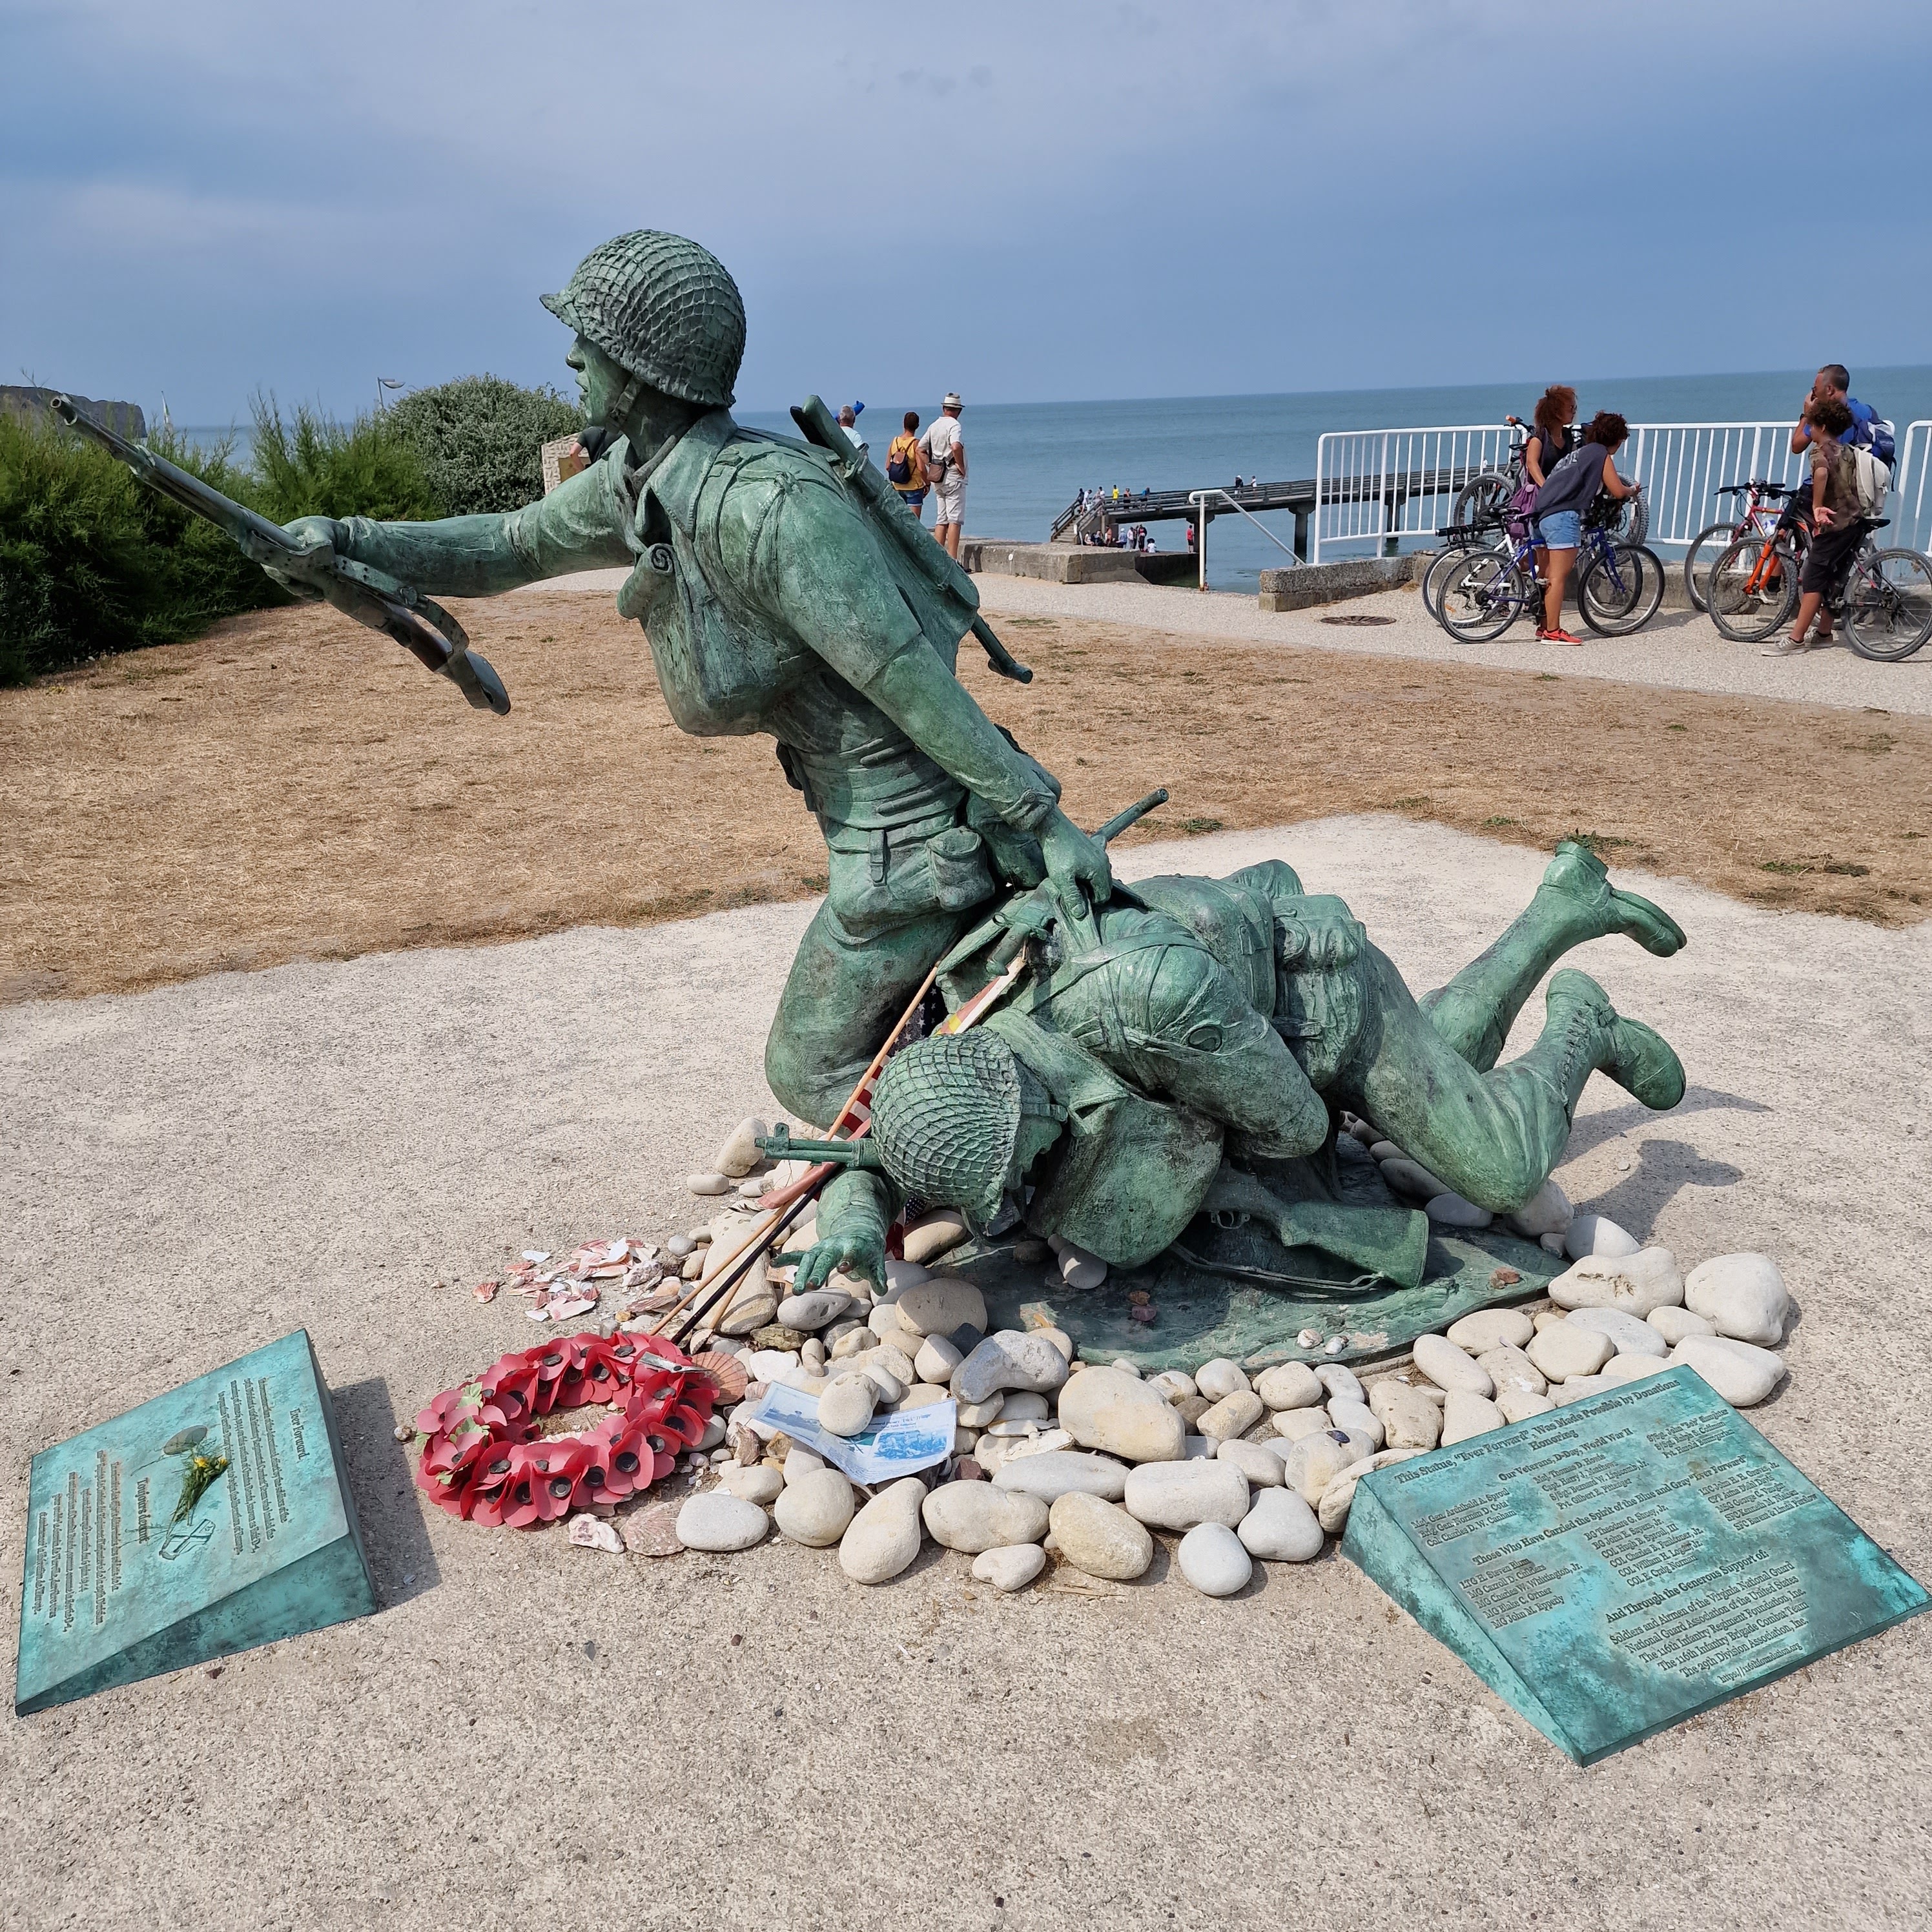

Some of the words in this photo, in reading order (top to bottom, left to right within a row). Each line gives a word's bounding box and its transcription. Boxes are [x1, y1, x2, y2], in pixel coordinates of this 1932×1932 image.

[289, 1406, 303, 1428] Ever
[1393, 1468, 1421, 1484] This
[1417, 1455, 1459, 1477] Statue,
[1530, 1421, 1557, 1435] Was
[1553, 1411, 1585, 1427] Made
[1579, 1397, 1623, 1418] Possible
[1618, 1393, 1638, 1406] by
[1630, 1377, 1681, 1400] Donations
[293, 1423, 310, 1461] Forward
[1496, 1469, 1518, 1481] Our
[1513, 1455, 1557, 1476] Veterans,
[1551, 1445, 1585, 1463] D-Day,
[1577, 1436, 1608, 1452] World
[1604, 1430, 1626, 1442] War
[1621, 1427, 1634, 1436] II
[1526, 1427, 1579, 1452] Honoring
[1547, 1463, 1577, 1478] Thomas
[1582, 1452, 1607, 1465] Howie
[1557, 1472, 1583, 1487] Harry
[1584, 1459, 1619, 1476] Matthews
[1568, 1477, 1598, 1493] Bernard
[1594, 1474, 1608, 1483] W.
[1603, 1462, 1641, 1481] Lipscomb,
[1636, 1459, 1650, 1468] Jr.
[134, 1475, 150, 1517] Toujours
[1443, 1499, 1479, 1517] Archibald
[1483, 1487, 1512, 1503] Sproul
[1569, 1490, 1596, 1505] Gilbert
[1599, 1476, 1634, 1494] Pittenger
[1439, 1526, 1469, 1541] Charles
[1464, 1522, 1478, 1532] D.
[1474, 1518, 1489, 1528] W.
[1485, 1508, 1517, 1525] Canham
[1451, 1509, 1483, 1525] Norman
[1489, 1499, 1509, 1511] Cota
[1471, 1548, 1503, 1566] Those
[1497, 1540, 1523, 1556] Who
[1519, 1532, 1546, 1547] Have
[1541, 1519, 1577, 1538] Carried
[1572, 1514, 1592, 1526] the
[1587, 1505, 1617, 1522] Spirit
[1610, 1501, 1625, 1512] of
[1619, 1496, 1638, 1508] the
[1633, 1489, 1657, 1503] Blue
[1652, 1483, 1672, 1495] and
[1668, 1475, 1694, 1491] Gray
[1582, 1530, 1599, 1541] BG
[1594, 1517, 1629, 1536] Theodore
[1590, 1539, 1607, 1550] BG
[1602, 1532, 1624, 1545] John
[1599, 1546, 1620, 1559] COL
[1614, 1539, 1639, 1554] Hugh
[1641, 1526, 1671, 1543] Sproul,
[1665, 1523, 1680, 1533] III
[1608, 1556, 1629, 1568] COL
[1623, 1545, 1653, 1562] Charles
[1466, 1587, 1485, 1599] MG
[1481, 1577, 1509, 1593] Carroll
[1514, 1562, 1547, 1580] Childers
[1485, 1563, 1512, 1579] Steven
[1508, 1556, 1531, 1570] Blum
[1616, 1565, 1637, 1577] COL
[1632, 1554, 1663, 1571] William
[1625, 1574, 1646, 1587] COL
[1648, 1563, 1673, 1579] Craig
[1666, 1553, 1698, 1570] Norman
[1474, 1596, 1493, 1609] MG
[1488, 1586, 1519, 1603] Charles
[1514, 1582, 1530, 1592] W.
[1525, 1565, 1574, 1590] Whittington,
[1568, 1561, 1583, 1571] Jr.
[1481, 1606, 1501, 1619] MG
[1496, 1598, 1521, 1613] Blake
[1525, 1585, 1554, 1601] Ortner
[1601, 1607, 1628, 1623] And
[1621, 1590, 1669, 1617] Through
[1660, 1585, 1681, 1599] the
[1676, 1567, 1723, 1592] Generous
[1717, 1553, 1760, 1577] Support
[1752, 1548, 1770, 1560] of:
[1490, 1616, 1509, 1629] MG
[1505, 1609, 1527, 1623] John
[1534, 1594, 1568, 1614] Epperly
[1607, 1623, 1645, 1645] Soldiers
[1639, 1617, 1661, 1632] and
[1654, 1605, 1689, 1625] Airmen
[1683, 1601, 1699, 1612] of
[1692, 1596, 1712, 1608] the
[1705, 1583, 1743, 1605] Virginia
[1735, 1570, 1772, 1590] National
[1766, 1560, 1796, 1577] Guard
[1623, 1631, 1663, 1654] National
[1658, 1621, 1688, 1639] Guard
[1681, 1603, 1731, 1629] Association
[1725, 1598, 1741, 1610] of
[1734, 1593, 1752, 1607] the
[1747, 1583, 1778, 1601] United
[1771, 1573, 1800, 1590] States
[1637, 1649, 1660, 1664] The
[1654, 1639, 1681, 1657] 116th
[1674, 1625, 1715, 1649] Infantry
[1706, 1610, 1750, 1636] Regiment
[1742, 1591, 1793, 1619] Foundation,
[1656, 1656, 1678, 1672] The
[1672, 1647, 1700, 1665] 116th
[1693, 1633, 1733, 1657] Infantry
[1725, 1621, 1762, 1643] Brigade
[1754, 1608, 1789, 1629] Combat
[1782, 1599, 1810, 1616] Team
[1678, 1663, 1700, 1678] The
[1694, 1654, 1720, 1672] 29th
[1712, 1641, 1751, 1663] Division
[1743, 1621, 1796, 1650] Association,
